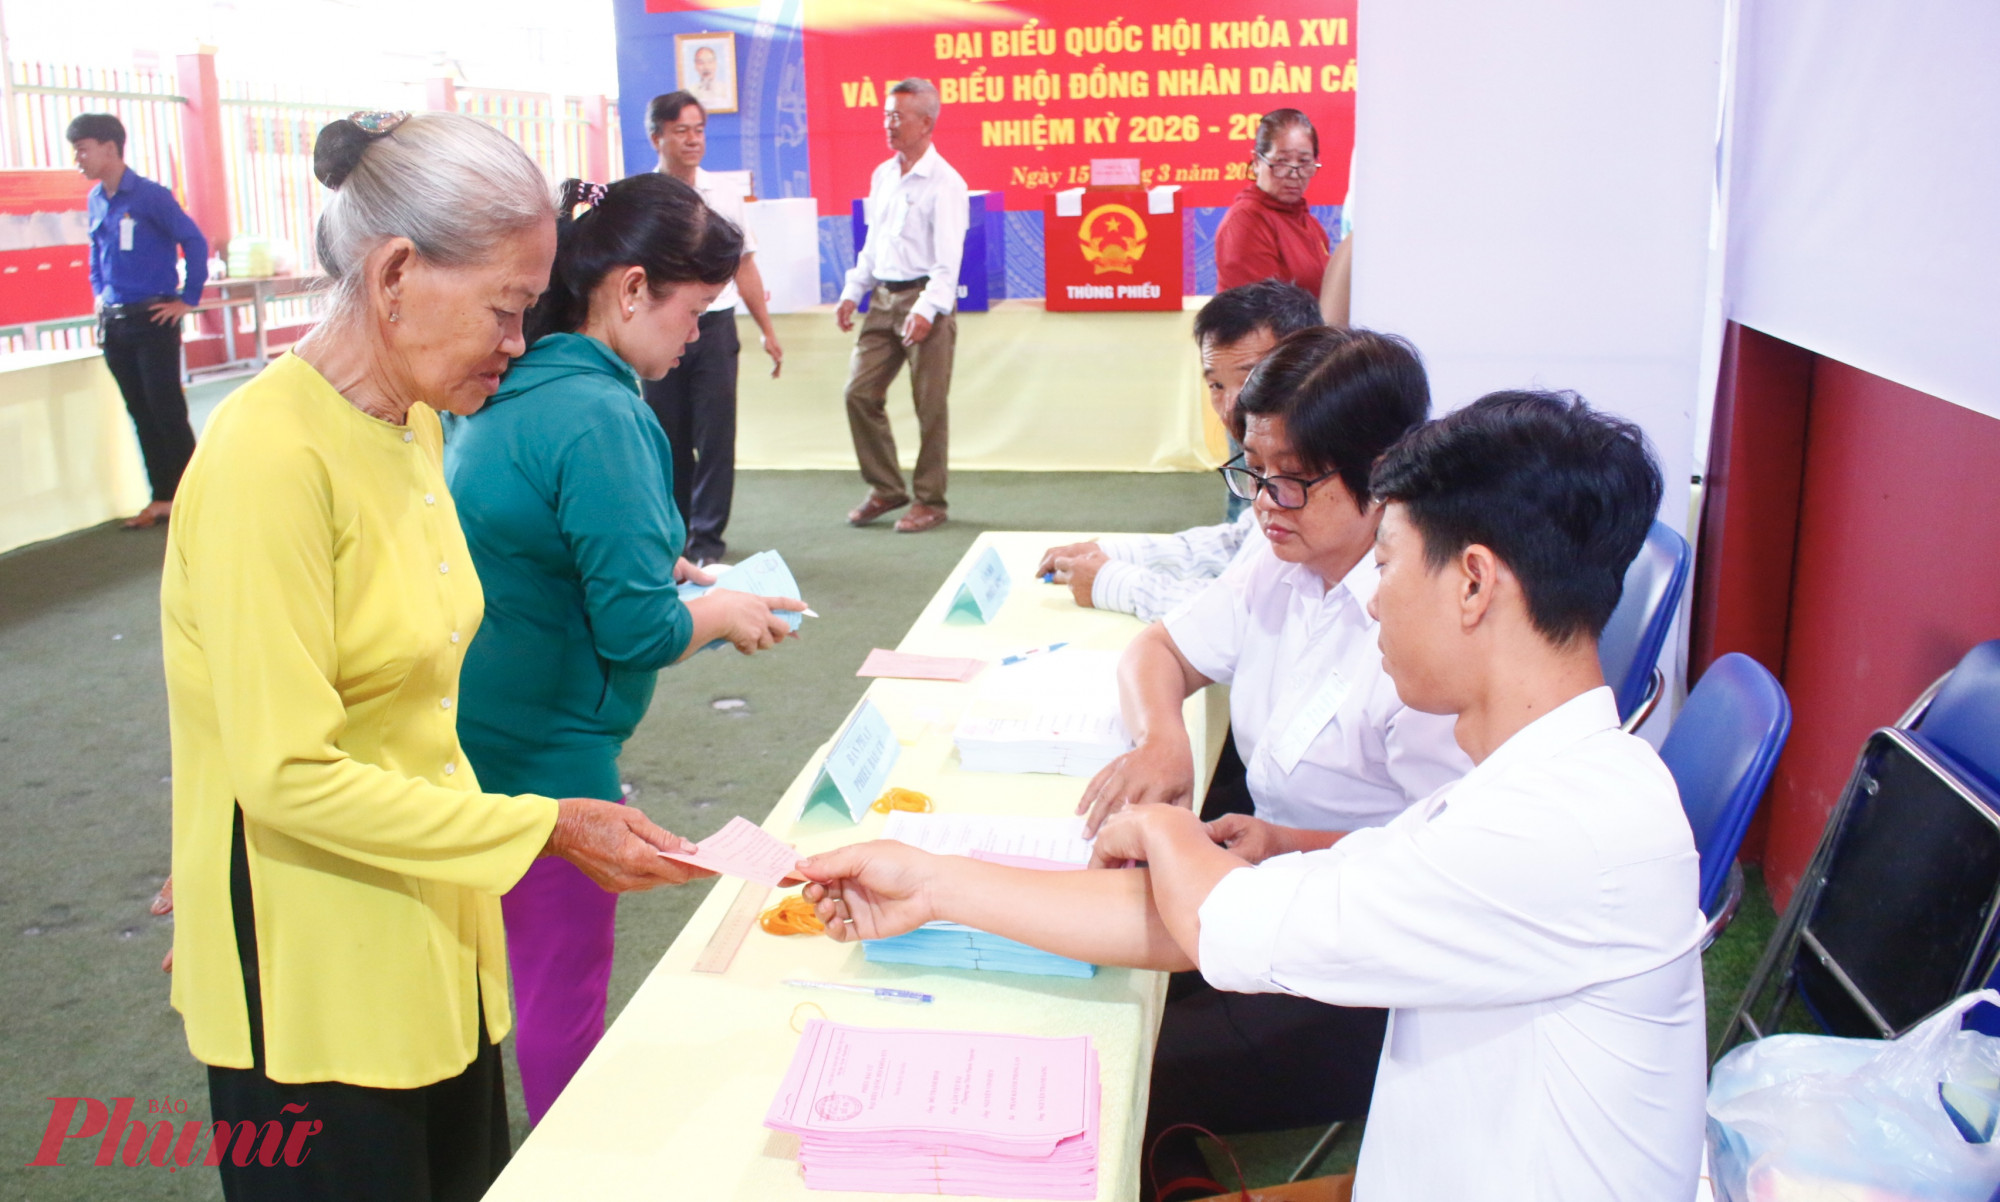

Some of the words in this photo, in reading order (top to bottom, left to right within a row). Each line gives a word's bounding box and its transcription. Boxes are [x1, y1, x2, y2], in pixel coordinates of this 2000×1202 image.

[935, 32, 983, 65] ĐẠI
[991, 18, 1056, 57] BIỂU
[1065, 16, 1143, 57] QUỐC
[1152, 18, 1201, 57] HỘI
[1210, 15, 1291, 50] KHÓA
[1299, 18, 1348, 47] XVI
[841, 76, 878, 108] VÀ
[940, 65, 1004, 104] BIỂU
[1012, 69, 1061, 107] HỘI
[1068, 63, 1149, 100] ĐỒNG
[1158, 63, 1241, 97] NHÂN
[1250, 61, 1312, 94] DÂN
[981, 114, 1075, 151] NHIỆM
[1083, 112, 1121, 144] KỲ
[1128, 114, 1200, 143] 2026
[1228, 113, 1263, 140] 20
[1010, 166, 1062, 189] Ngày
[1068, 165, 1091, 184] 15
[1157, 163, 1171, 182] 3
[1174, 163, 1220, 182] năm
[1066, 283, 1114, 299] THÙNG
[1117, 281, 1161, 299] PHIẾU
